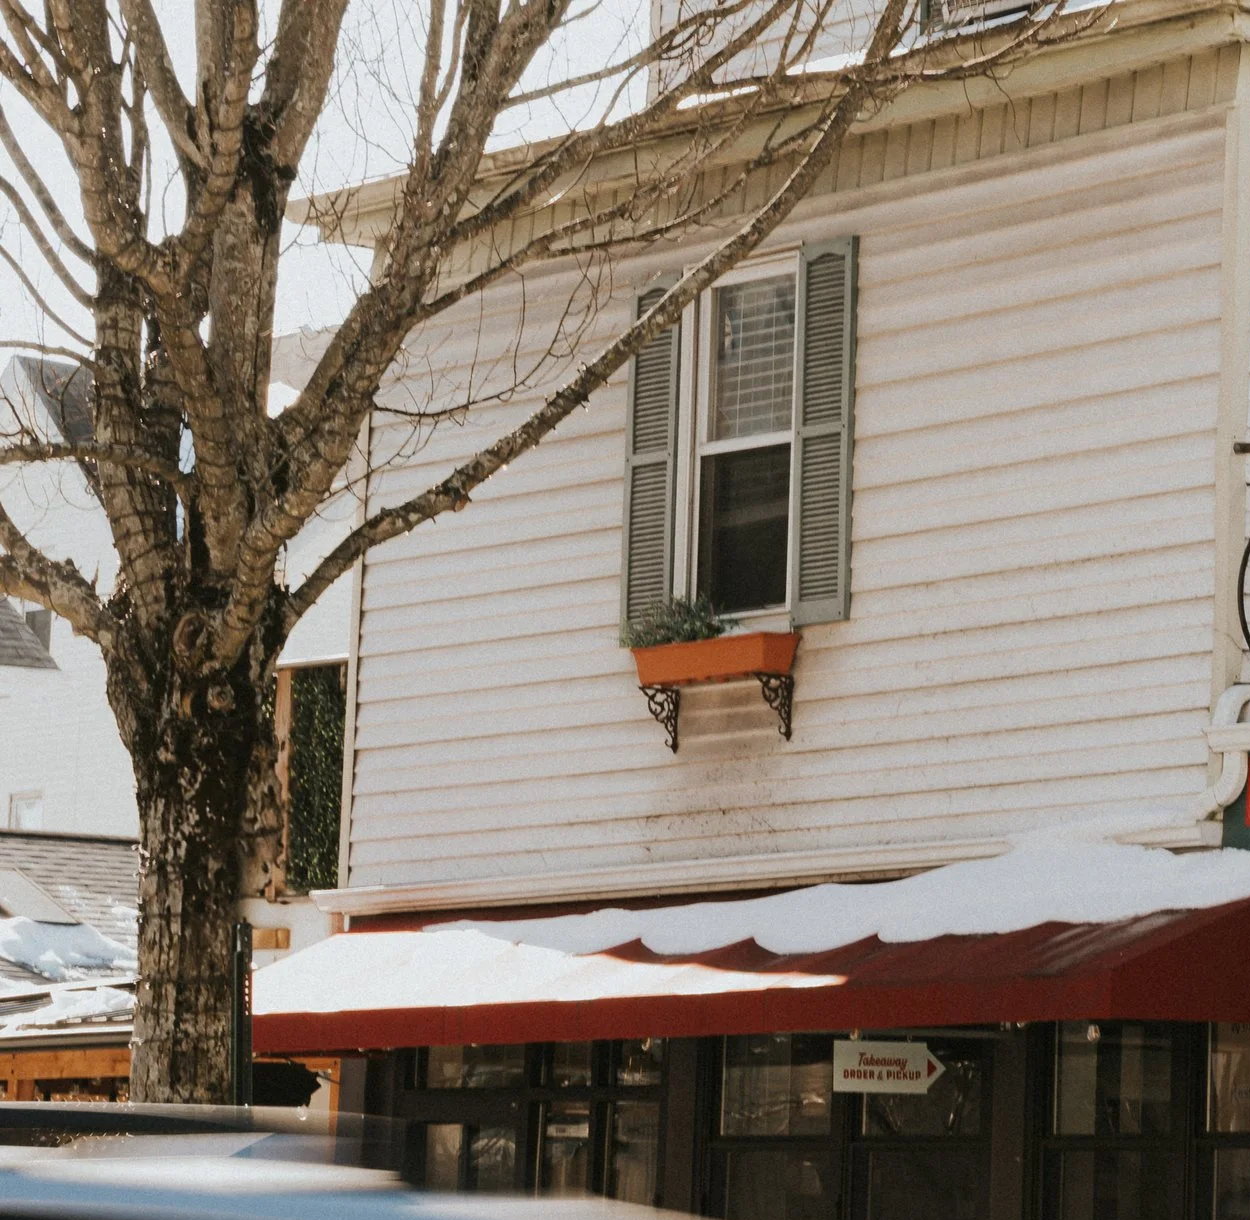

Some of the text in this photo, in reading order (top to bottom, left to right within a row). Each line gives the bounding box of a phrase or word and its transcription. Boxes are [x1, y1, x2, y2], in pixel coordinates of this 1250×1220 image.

[858, 1052, 908, 1071] Takeaway
[843, 1069, 922, 1081] ORDER & PICKUP
